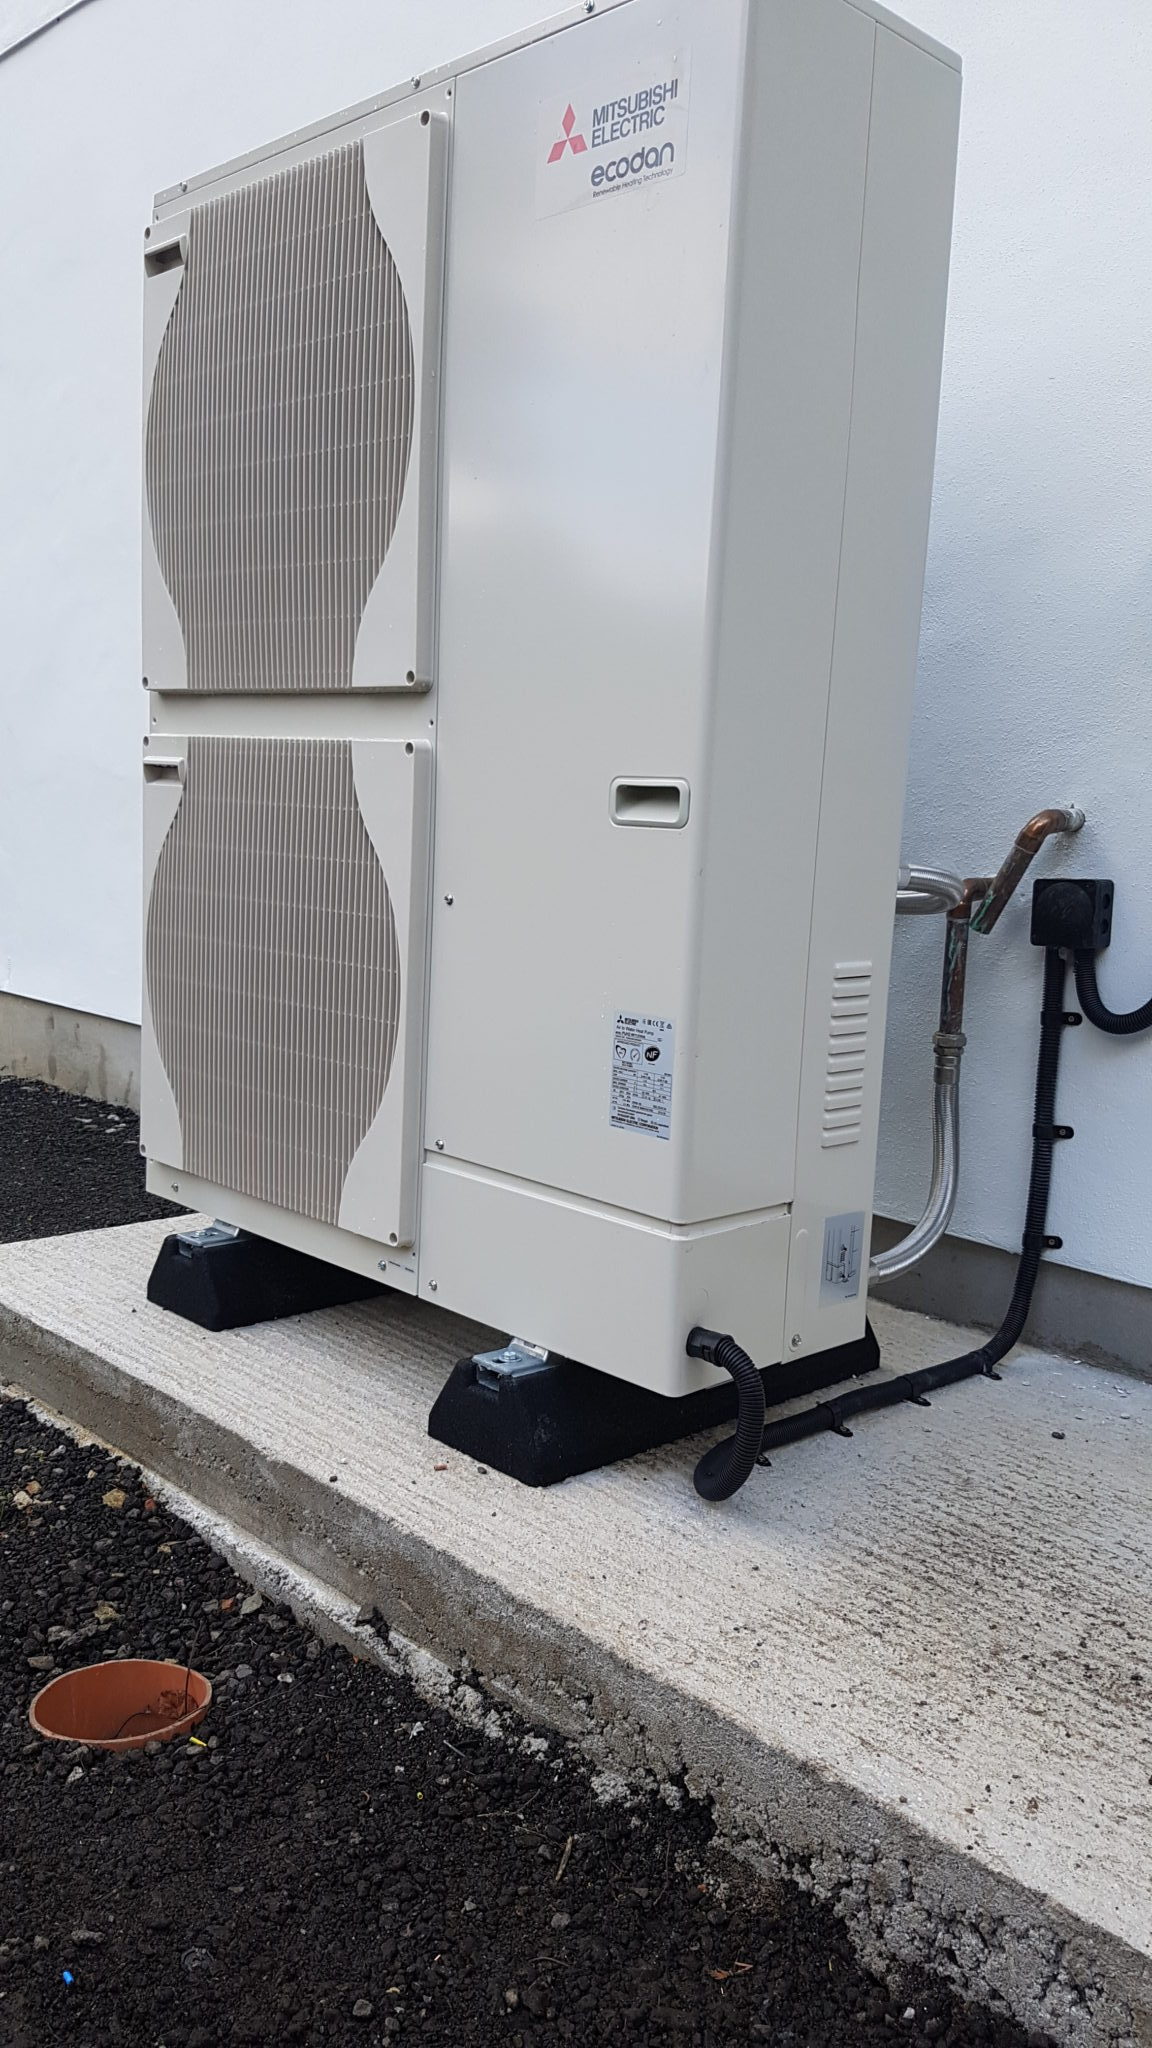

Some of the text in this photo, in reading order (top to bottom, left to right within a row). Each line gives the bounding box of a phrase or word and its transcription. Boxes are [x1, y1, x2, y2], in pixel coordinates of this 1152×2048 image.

[592, 78, 678, 128] MITSUBISHI
[591, 105, 665, 148] ELECTRIC
[591, 141, 674, 187] ecodan
[592, 168, 673, 198] Renewable Heating Technology
[646, 1050, 658, 1059] NF
